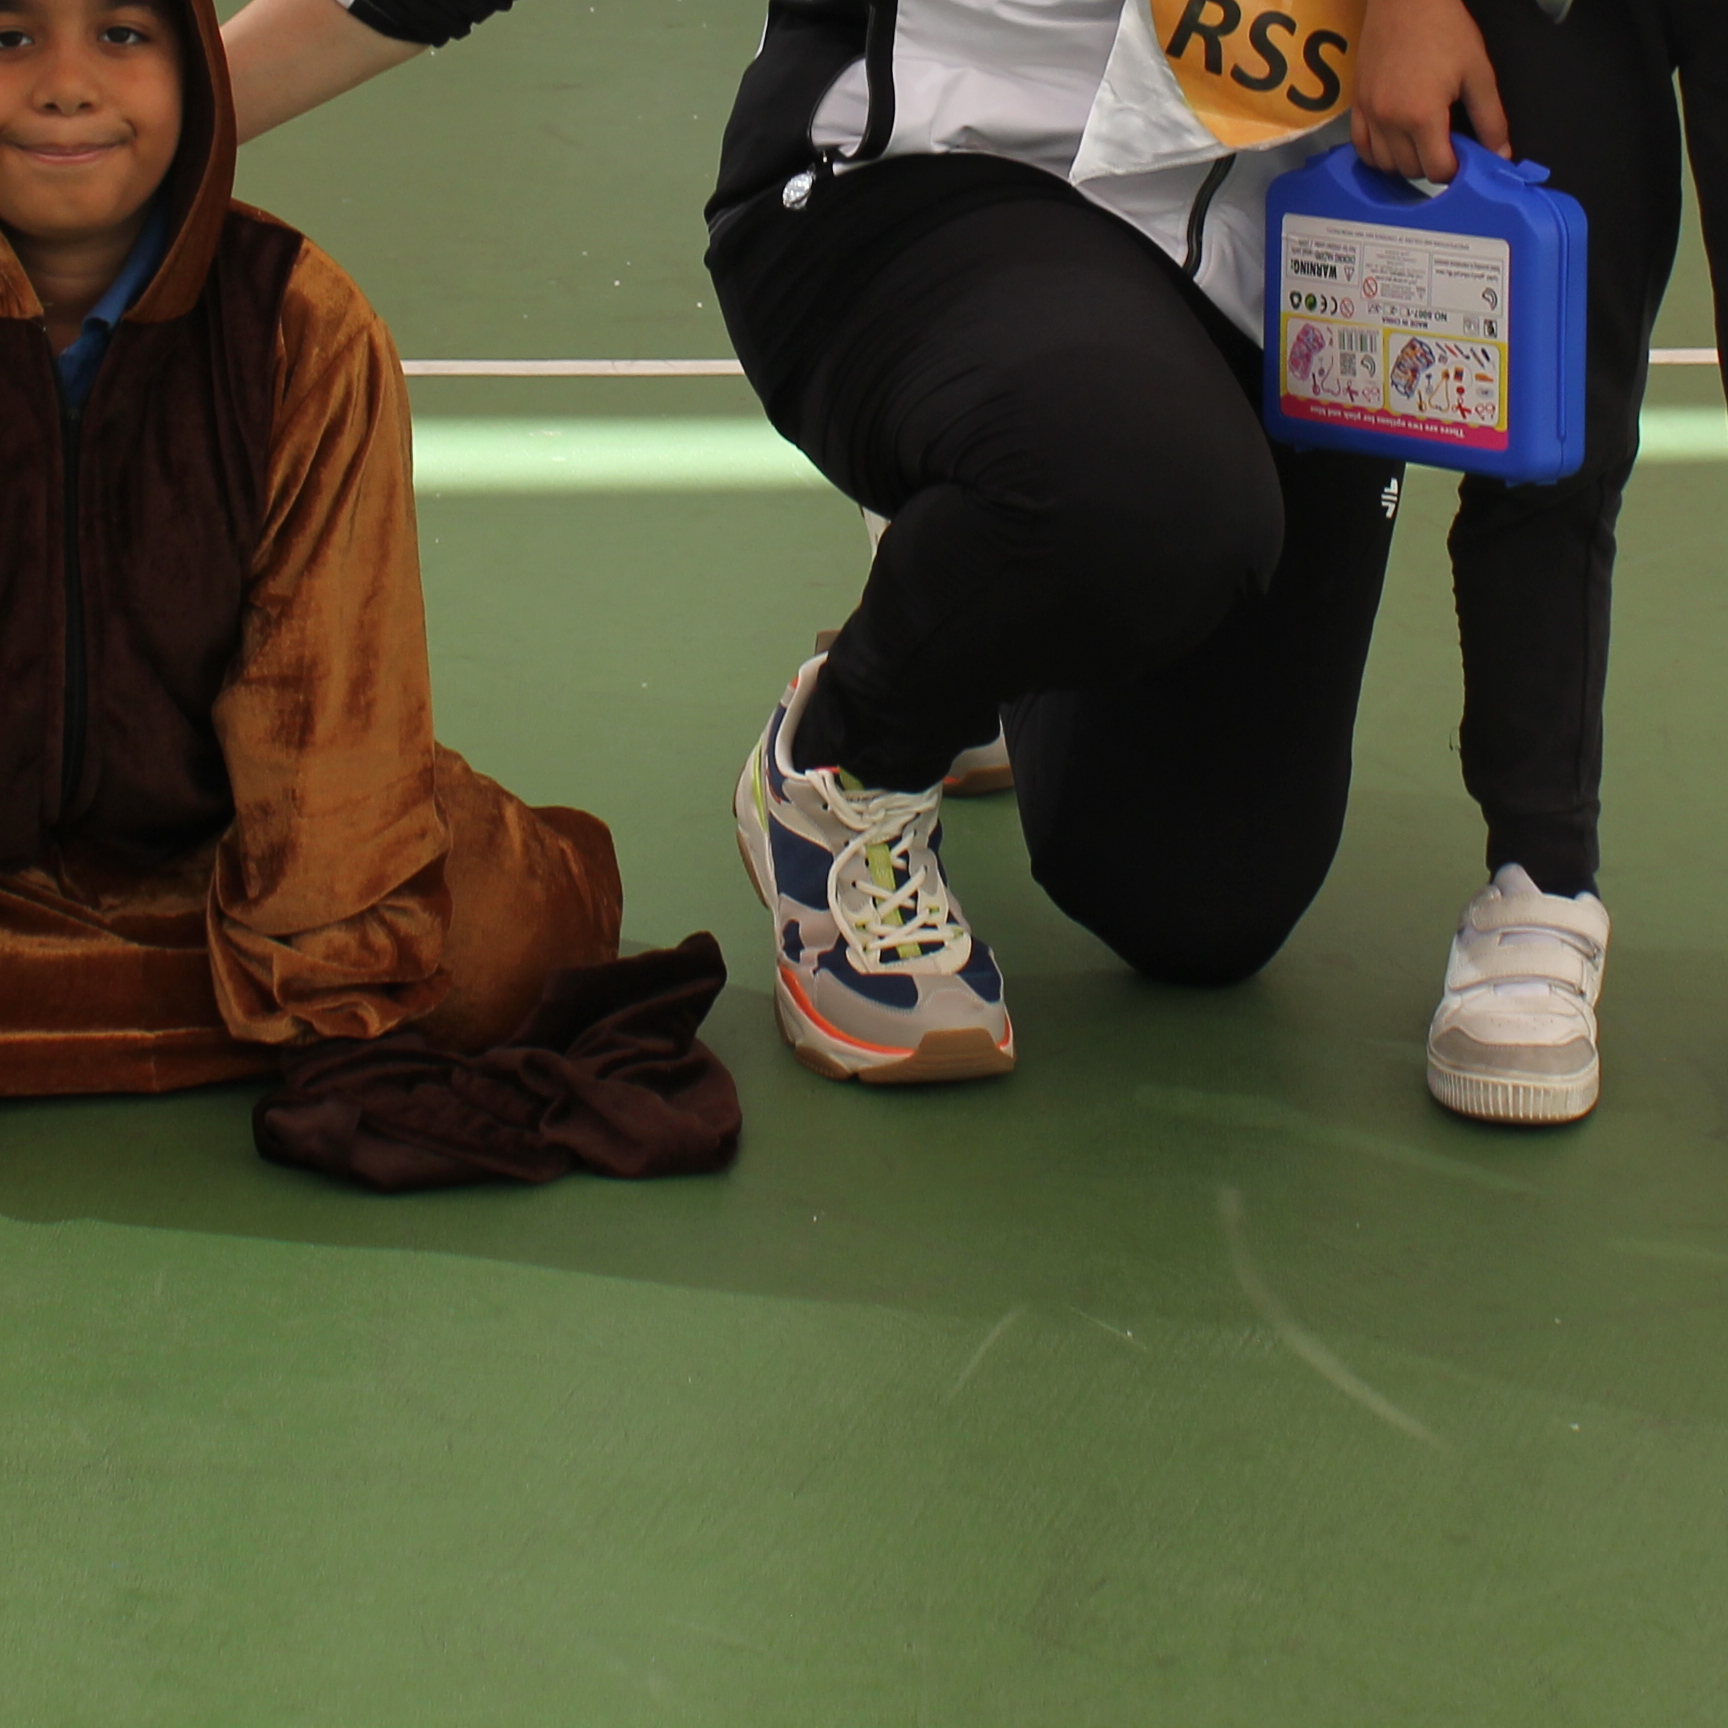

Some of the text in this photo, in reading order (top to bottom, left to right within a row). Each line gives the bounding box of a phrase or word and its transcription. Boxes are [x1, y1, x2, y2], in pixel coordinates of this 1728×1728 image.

[1291, 259, 1338, 281] WARNING:
[1382, 317, 1401, 325] CHINA
[1410, 321, 1429, 329] MADE
[1310, 406, 1465, 439] There are two options for pink and blue
